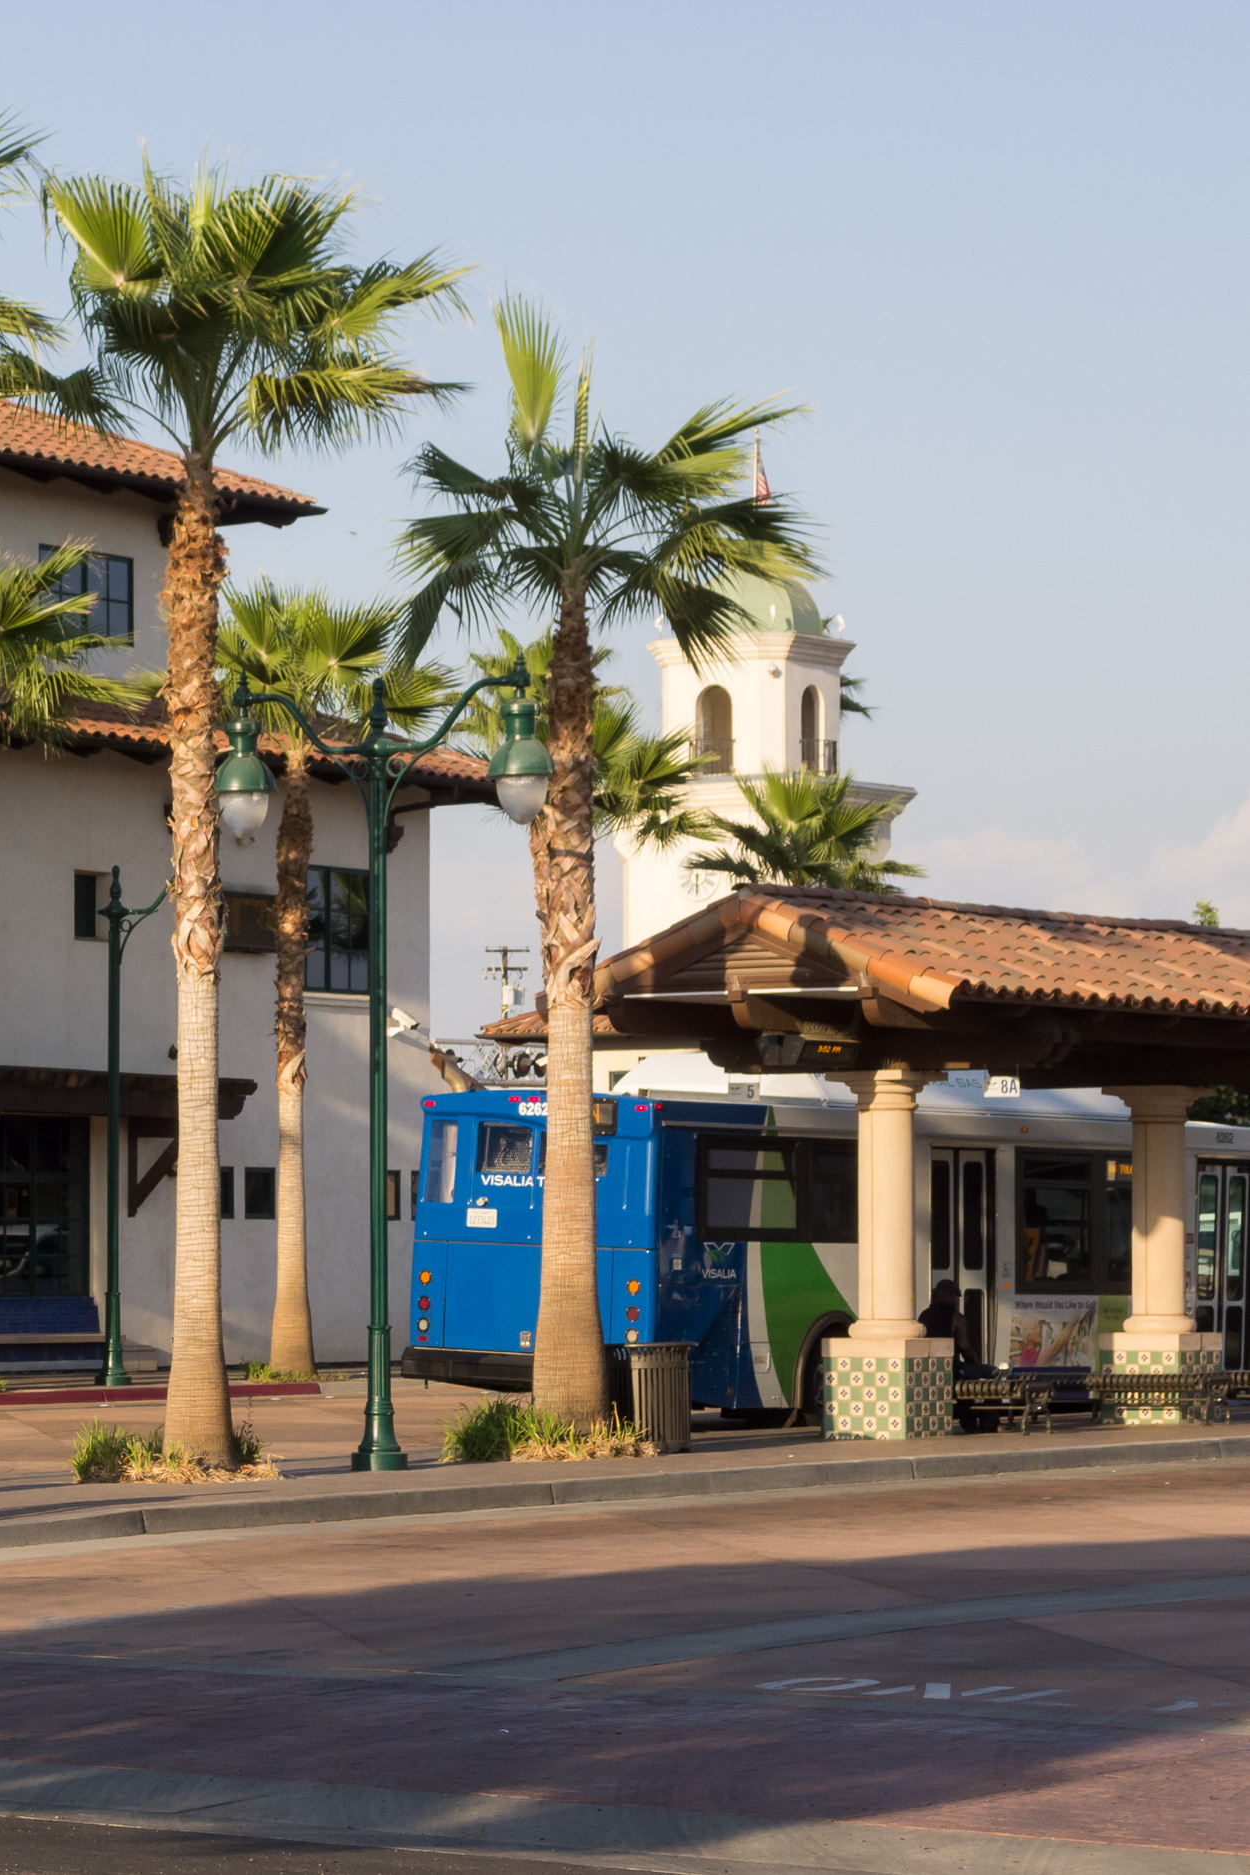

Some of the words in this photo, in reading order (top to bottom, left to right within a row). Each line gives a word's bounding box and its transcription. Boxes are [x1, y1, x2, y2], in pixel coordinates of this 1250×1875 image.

[955, 1078, 982, 1089] GAS
[1000, 1079, 1018, 1094] 8A
[746, 1084, 755, 1099] 5
[518, 1102, 548, 1116] 6262
[1216, 1131, 1234, 1144] 6262
[481, 1174, 534, 1187] VISALIA
[702, 1268, 737, 1279] VISALIA
[1035, 1300, 1053, 1309] Would
[1054, 1300, 1065, 1309] You
[1078, 1300, 1084, 1309] to
